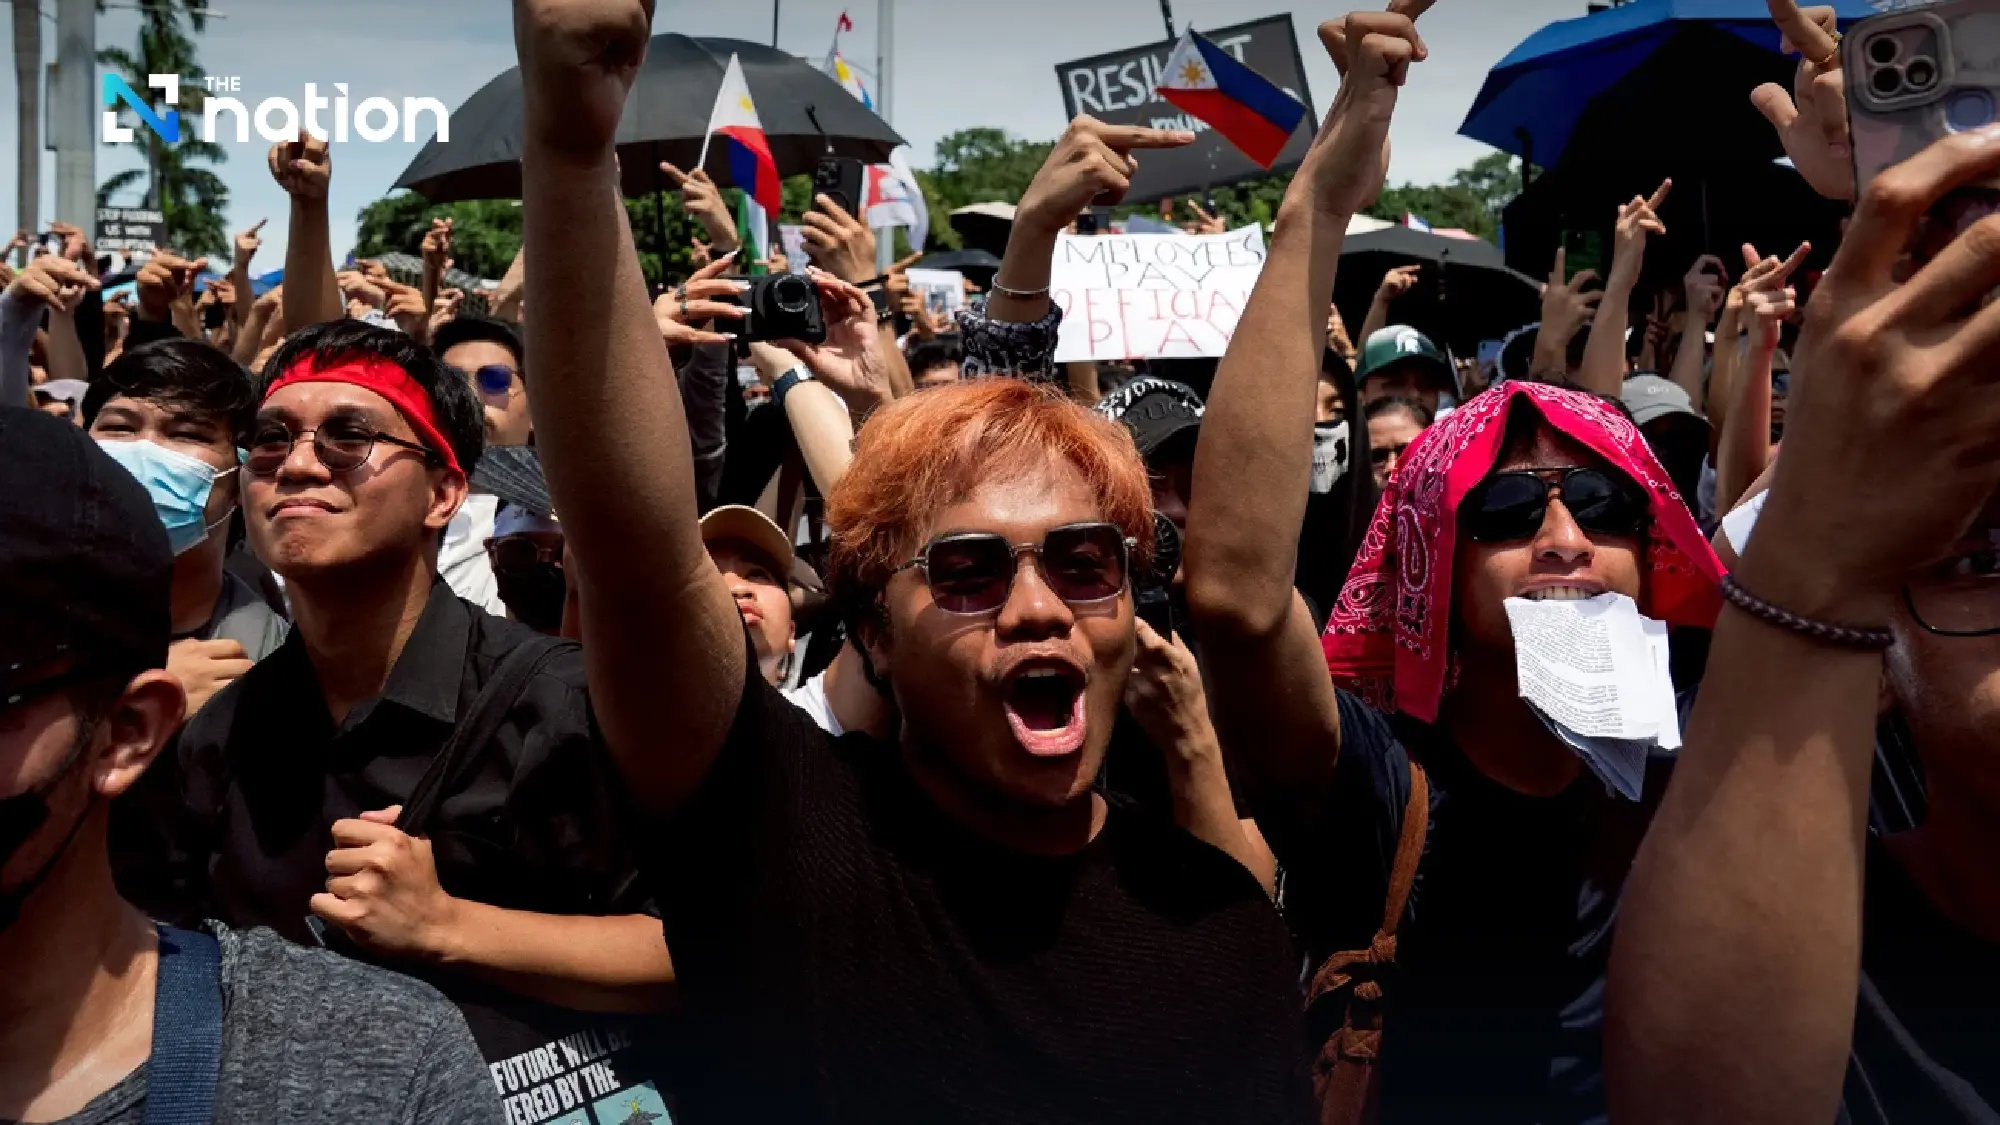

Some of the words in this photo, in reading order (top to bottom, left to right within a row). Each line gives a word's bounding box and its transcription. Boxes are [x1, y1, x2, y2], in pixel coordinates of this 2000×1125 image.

[1068, 34, 1252, 115] RESILT
[1105, 261, 1216, 291] PAY
[488, 1041, 565, 1095] FUTURE
[557, 1028, 608, 1068] WILL
[554, 1070, 585, 1111] BY
[579, 1058, 621, 1098] THE
